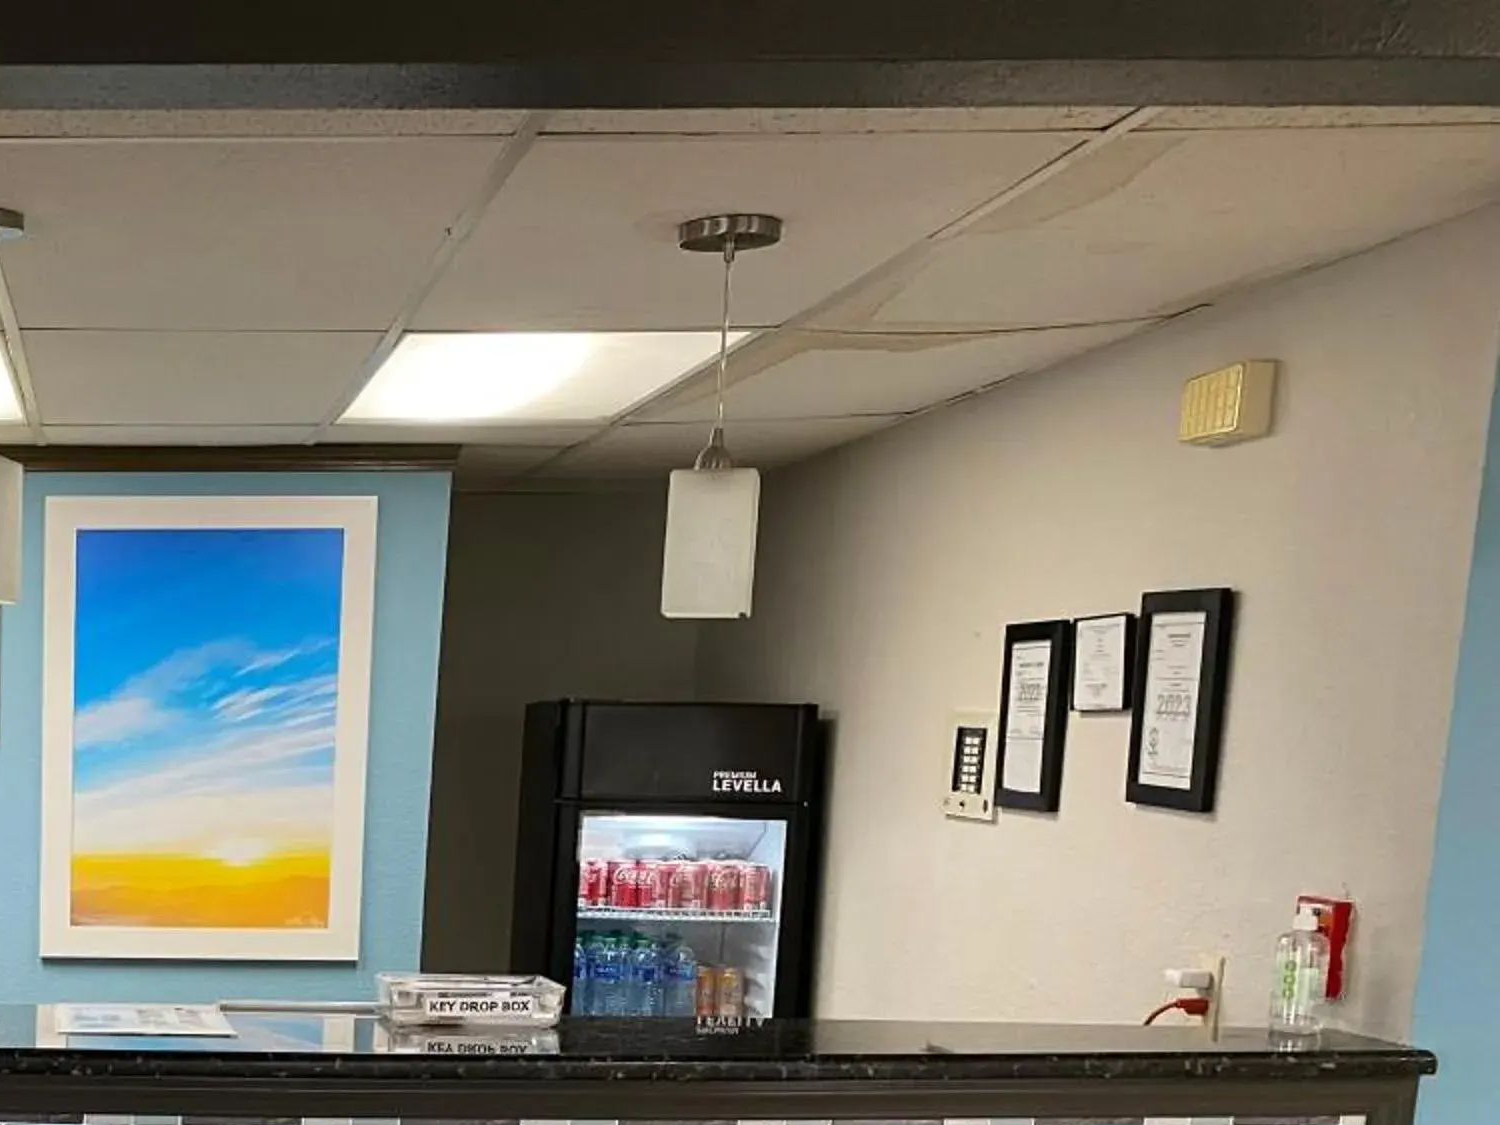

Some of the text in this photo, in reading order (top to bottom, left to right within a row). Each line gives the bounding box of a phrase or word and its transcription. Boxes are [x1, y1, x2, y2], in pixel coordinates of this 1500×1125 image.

[712, 779, 782, 793] LEVELLA
[429, 1000, 531, 1013] KEY DROP BOX
